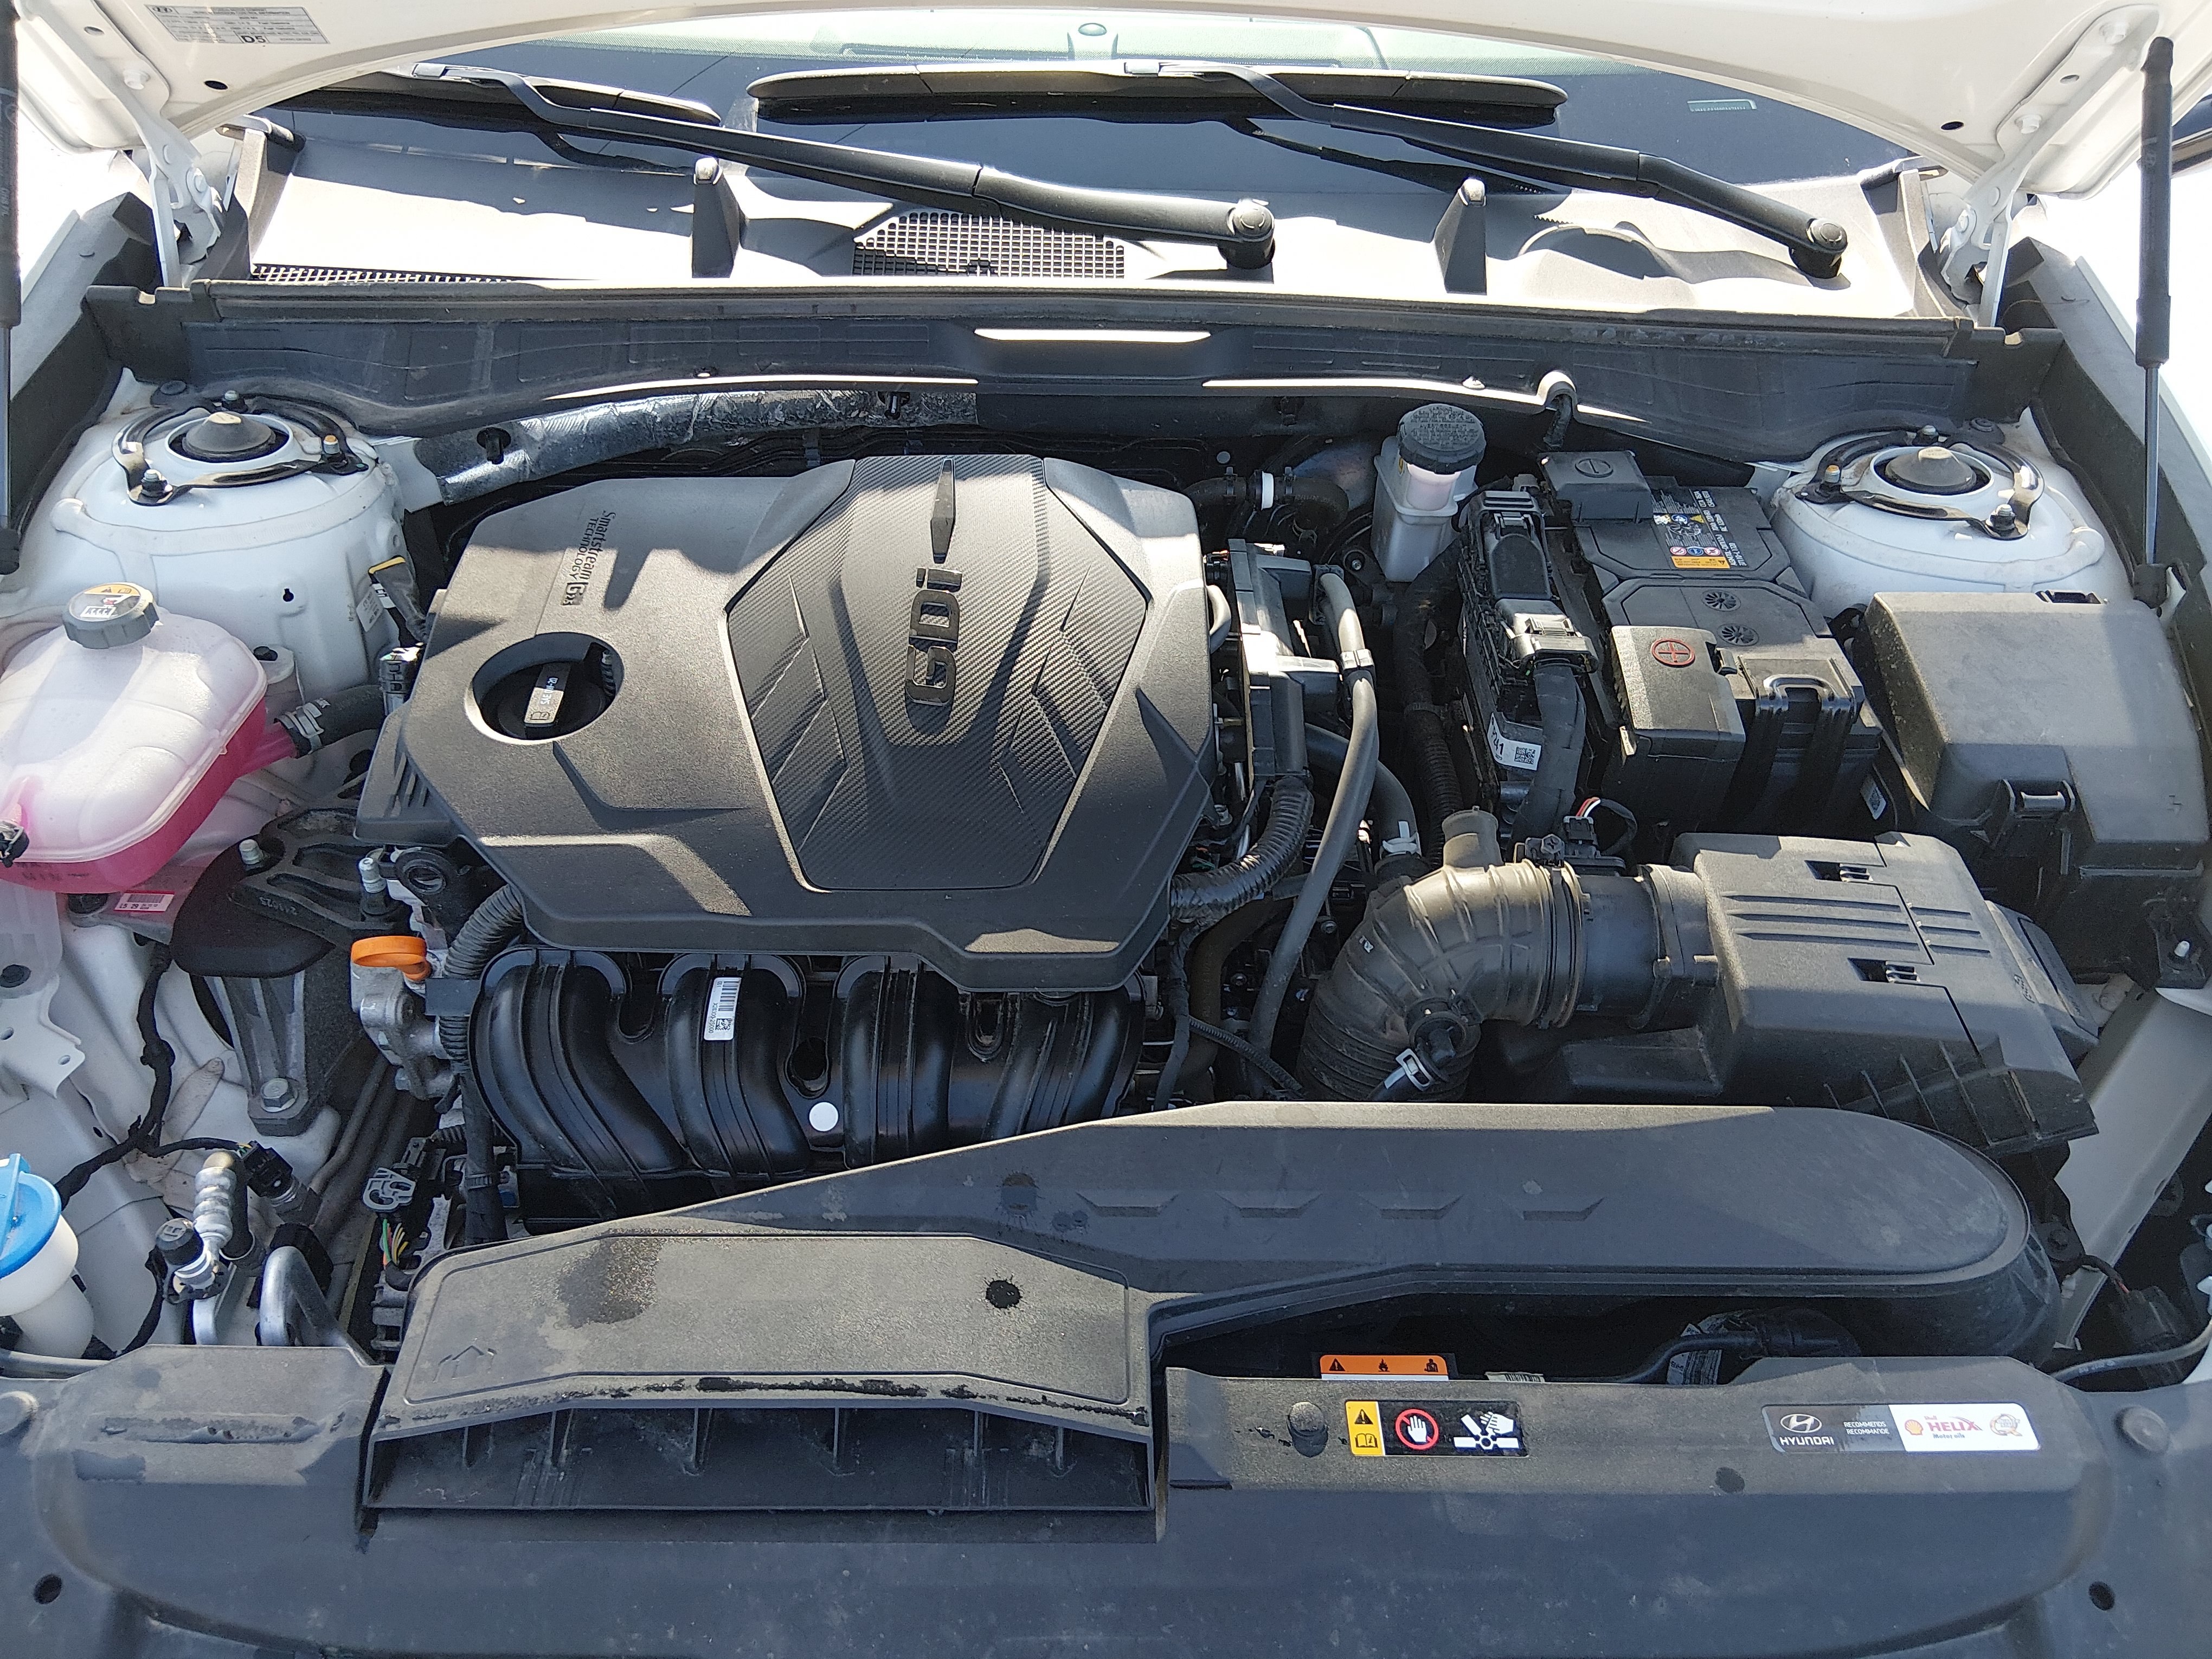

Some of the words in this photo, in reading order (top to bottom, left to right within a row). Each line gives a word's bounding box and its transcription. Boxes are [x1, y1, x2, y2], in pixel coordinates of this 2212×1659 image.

[569, 517, 599, 581] TECHNOLOGY
[579, 510, 616, 580] Smartstream
[540, 694, 552, 705] SAE
[1927, 1421, 1980, 1431] HELIX
[1779, 1436, 1835, 1446] HYUNDAI
